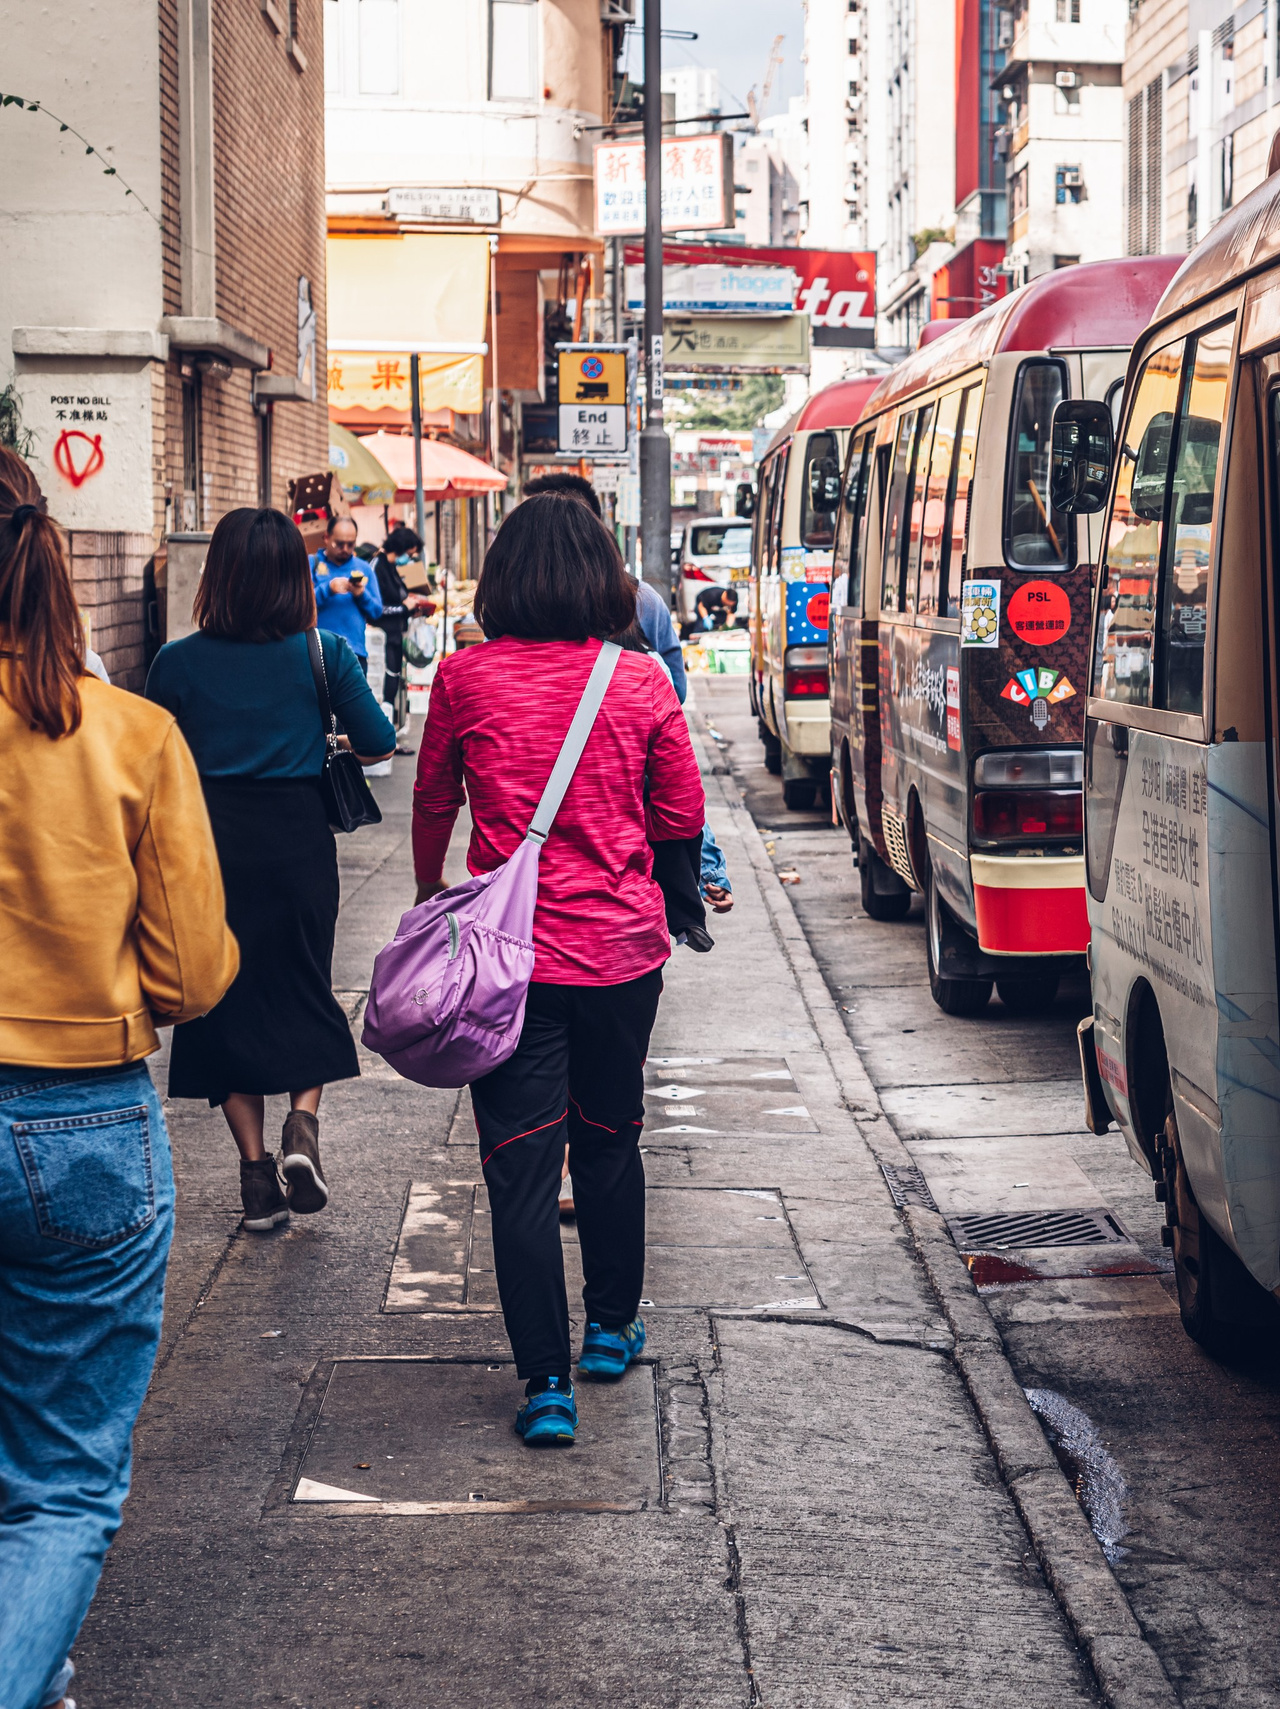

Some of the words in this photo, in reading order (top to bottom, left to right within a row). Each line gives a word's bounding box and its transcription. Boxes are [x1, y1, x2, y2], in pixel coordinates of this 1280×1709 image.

[50, 396, 75, 405] POST
[77, 396, 90, 405] NO
[92, 397, 111, 406] BILL
[578, 410, 608, 424] End
[572, 428, 613, 446] 終止
[1027, 592, 1051, 603] PSL
[1010, 671, 1071, 702] CIBS
[1142, 810, 1199, 887] 全港首間女性
[1145, 882, 1202, 966] 脫髮治療中心
